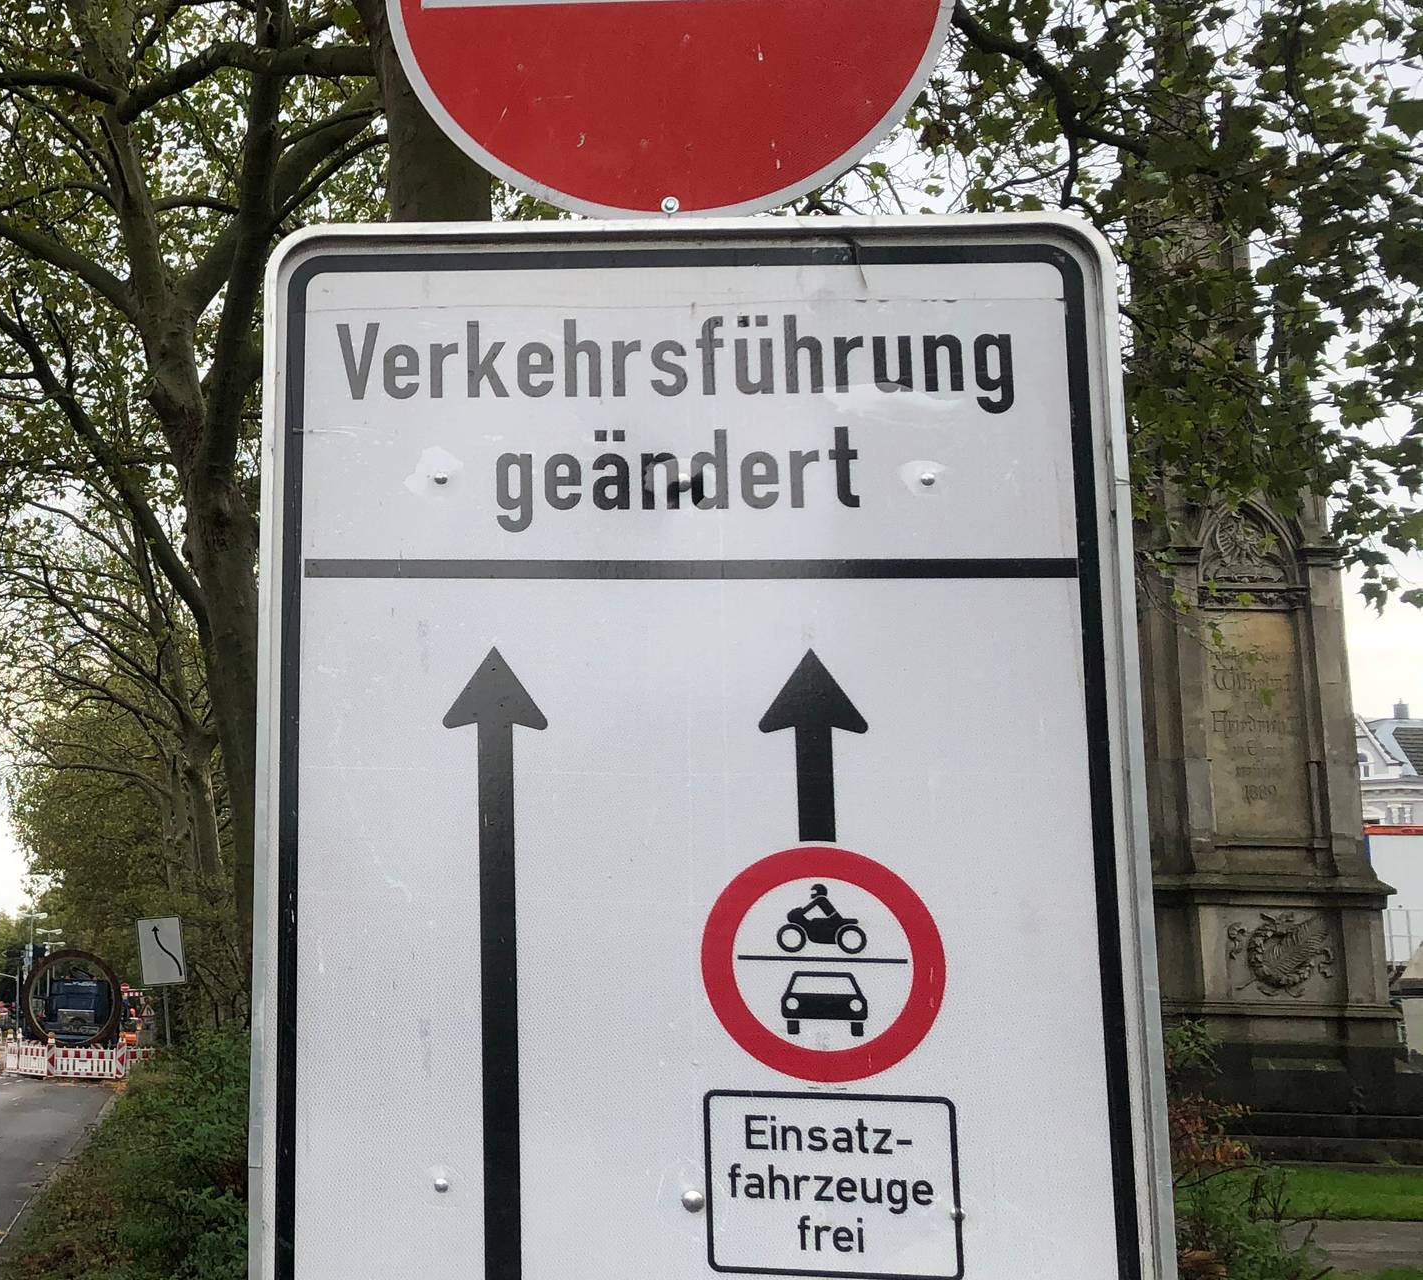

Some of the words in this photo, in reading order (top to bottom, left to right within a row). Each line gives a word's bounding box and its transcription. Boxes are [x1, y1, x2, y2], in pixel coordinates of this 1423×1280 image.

[335, 313, 1015, 415] Verkehrsführung
[495, 425, 862, 534] geändert
[743, 1113, 913, 1156] Einsatz-
[727, 1162, 934, 1215] fahrzeuge
[796, 1214, 866, 1254] frei
